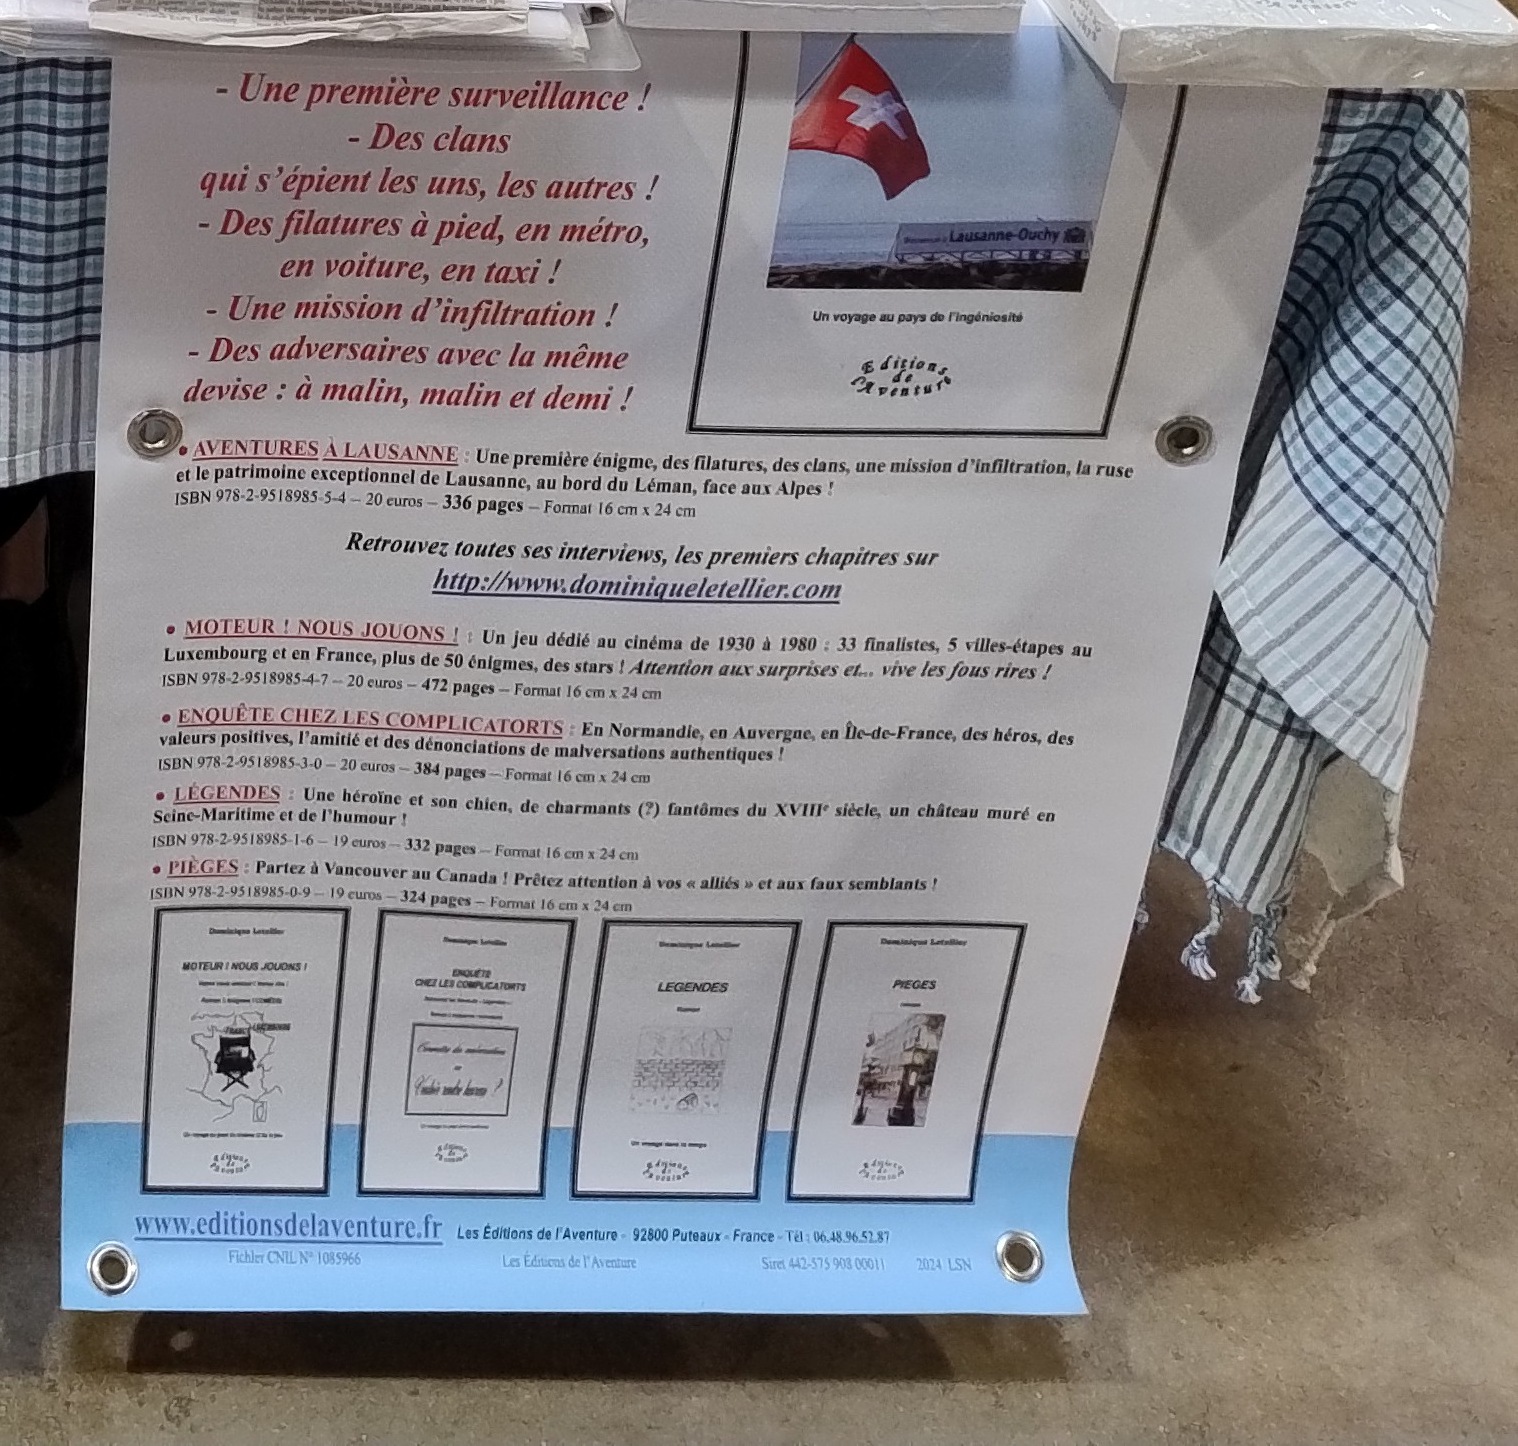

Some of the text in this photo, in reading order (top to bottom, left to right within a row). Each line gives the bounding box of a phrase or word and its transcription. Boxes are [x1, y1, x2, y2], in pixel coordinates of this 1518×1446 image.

[367, 123, 424, 150] Des
[433, 124, 511, 153] clans
[200, 164, 249, 198] qui
[377, 166, 418, 194] les
[427, 176, 485, 201] uns,
[496, 170, 537, 198] les
[544, 176, 636, 200] autres
[947, 227, 1061, 246] Lausanne-Ouchy
[279, 259, 314, 278] en
[325, 253, 429, 284] voiture,
[440, 263, 475, 282] en
[484, 258, 541, 284] taxi
[431, 567, 841, 604] http://www.dominiqueletellier.com
[153, 807, 274, 823] Seine-Maritime
[279, 810, 292, 821] et
[298, 809, 316, 822] de
[657, 981, 729, 993] LEGENDES
[891, 979, 936, 989] PIEGES
[133, 1210, 442, 1241] www.editionsdelaventure.fr
[457, 1224, 479, 1239] Les
[482, 1222, 533, 1240] Éditions
[536, 1226, 551, 1240] de
[632, 1227, 668, 1241] 92800
[671, 1227, 721, 1242] Puteaux
[733, 1228, 775, 1243] France
